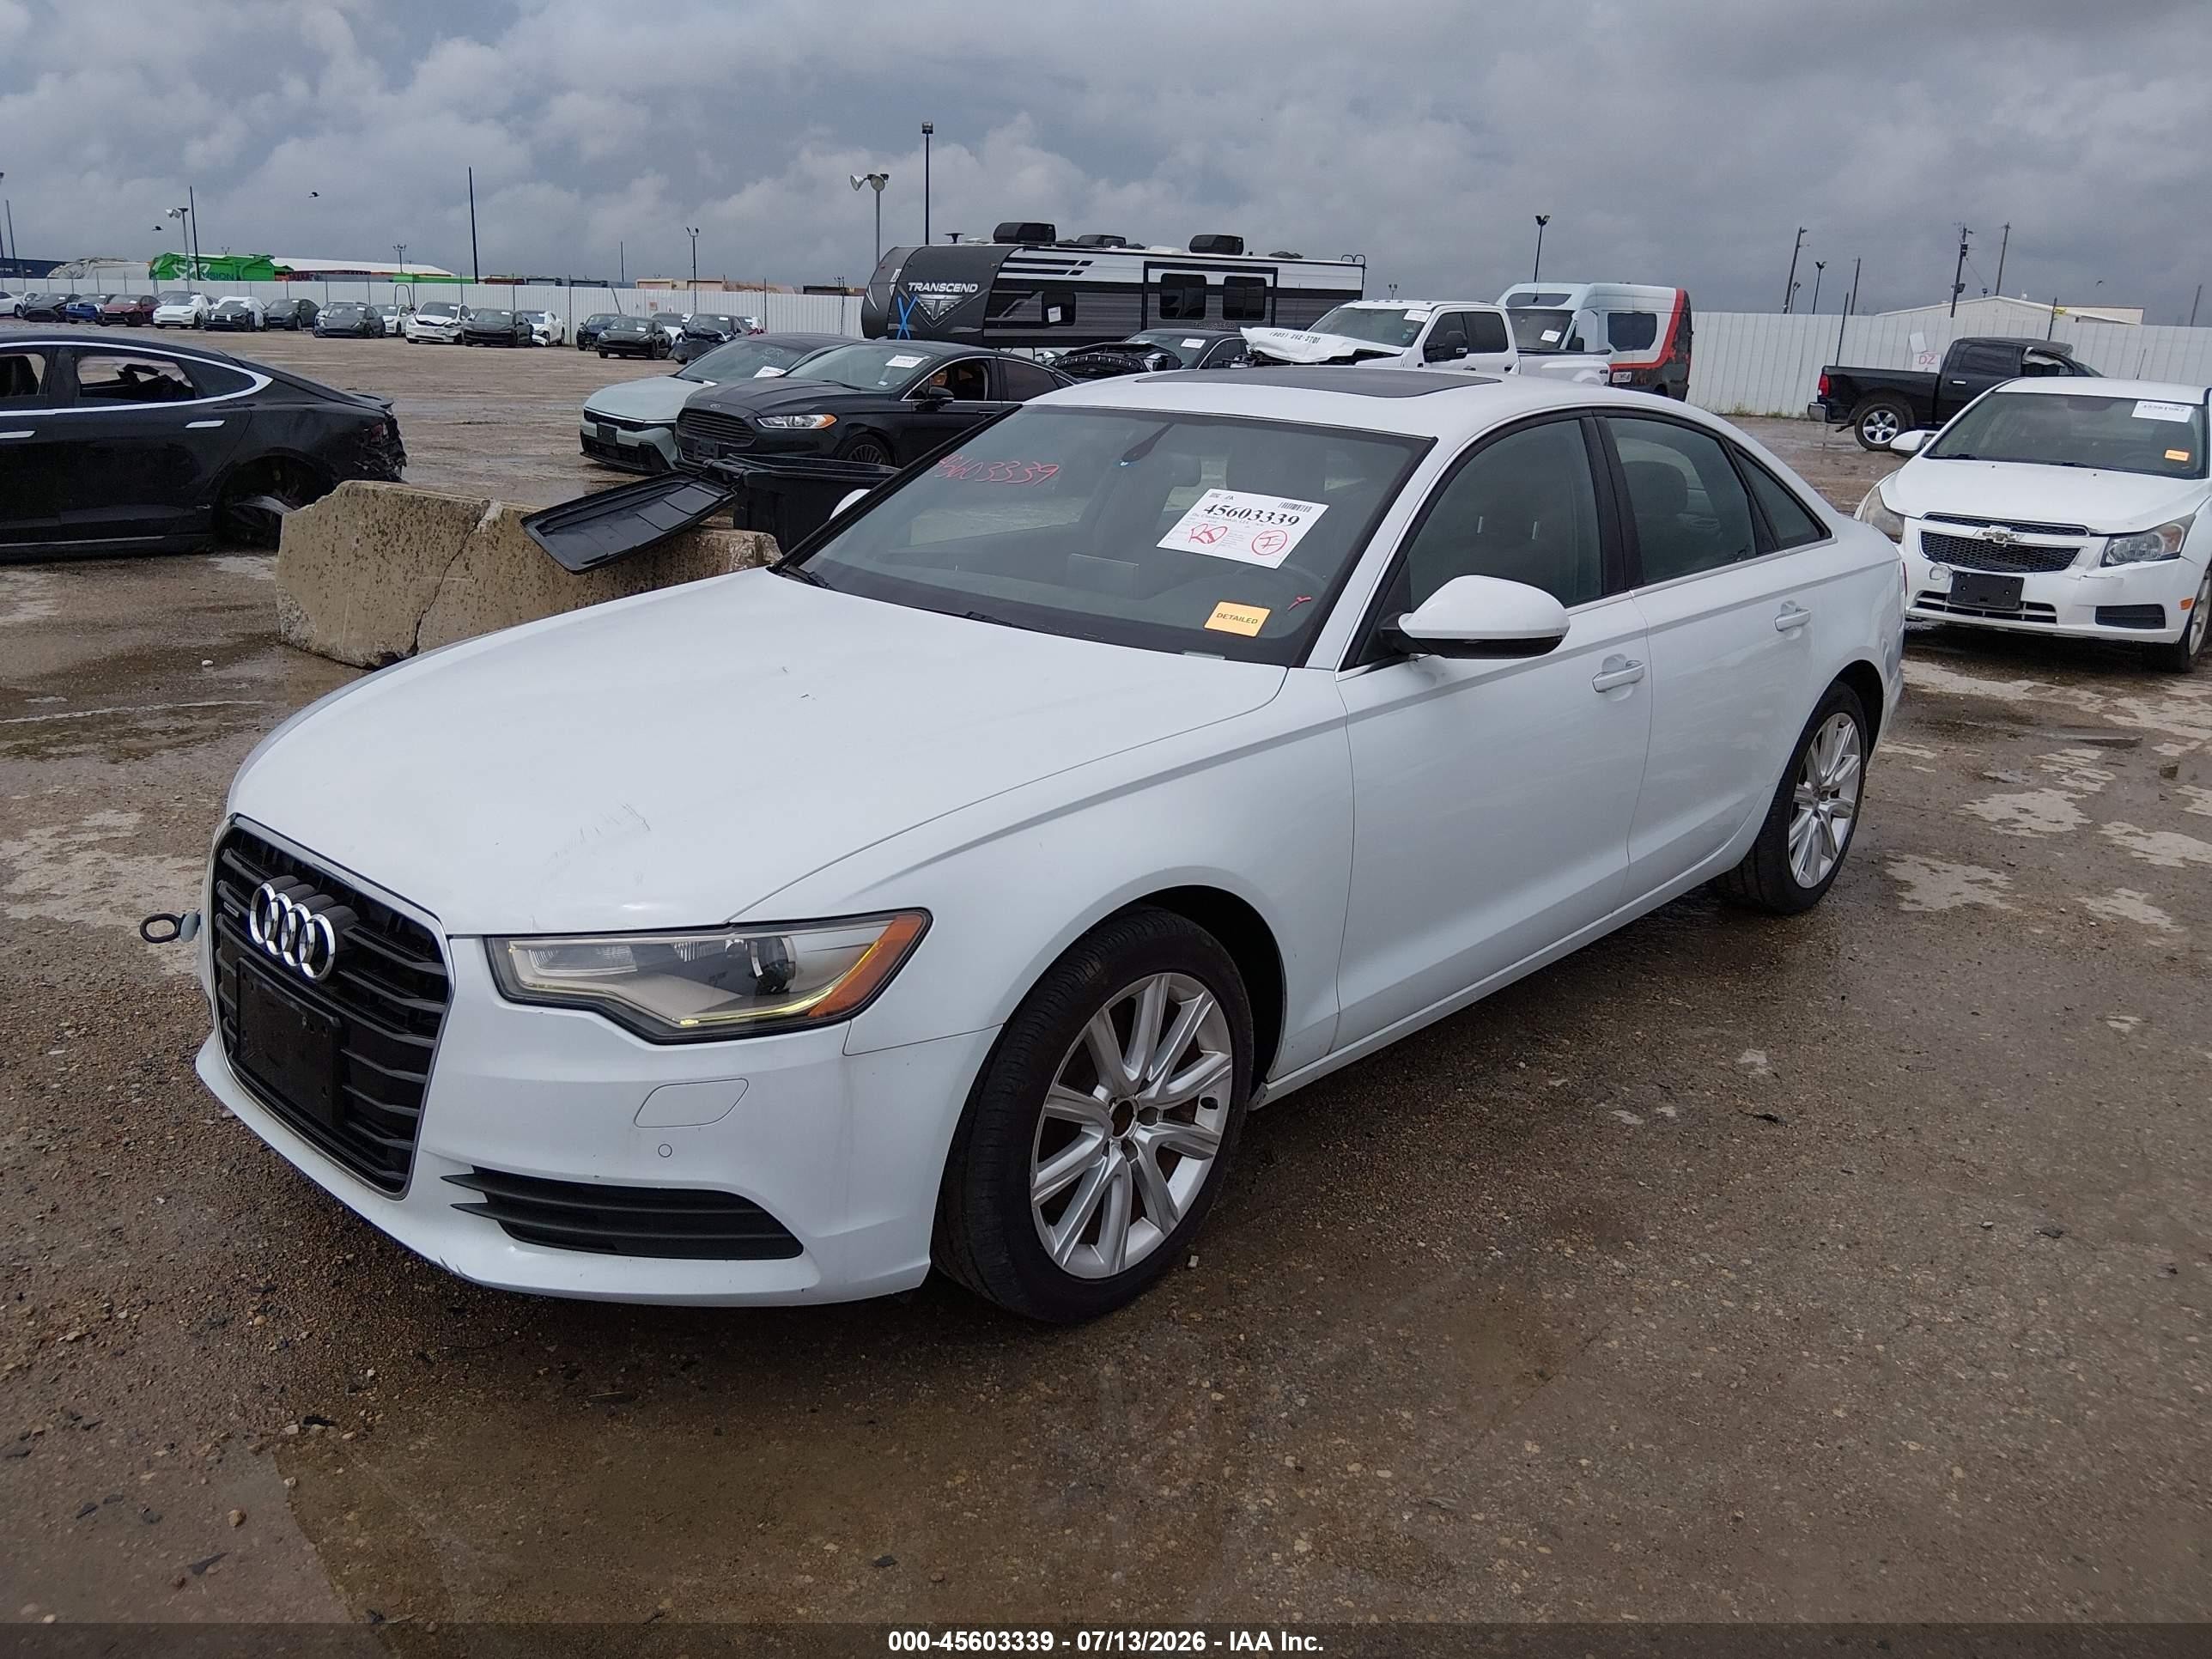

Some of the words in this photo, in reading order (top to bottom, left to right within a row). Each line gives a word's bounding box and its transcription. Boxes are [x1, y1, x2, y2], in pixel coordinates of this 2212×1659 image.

[907, 282, 979, 294] TRANSCEND
[1918, 355, 1936, 365] DZ
[1204, 503, 1300, 526] 45603339
[1216, 612, 1258, 624] DETAILED
